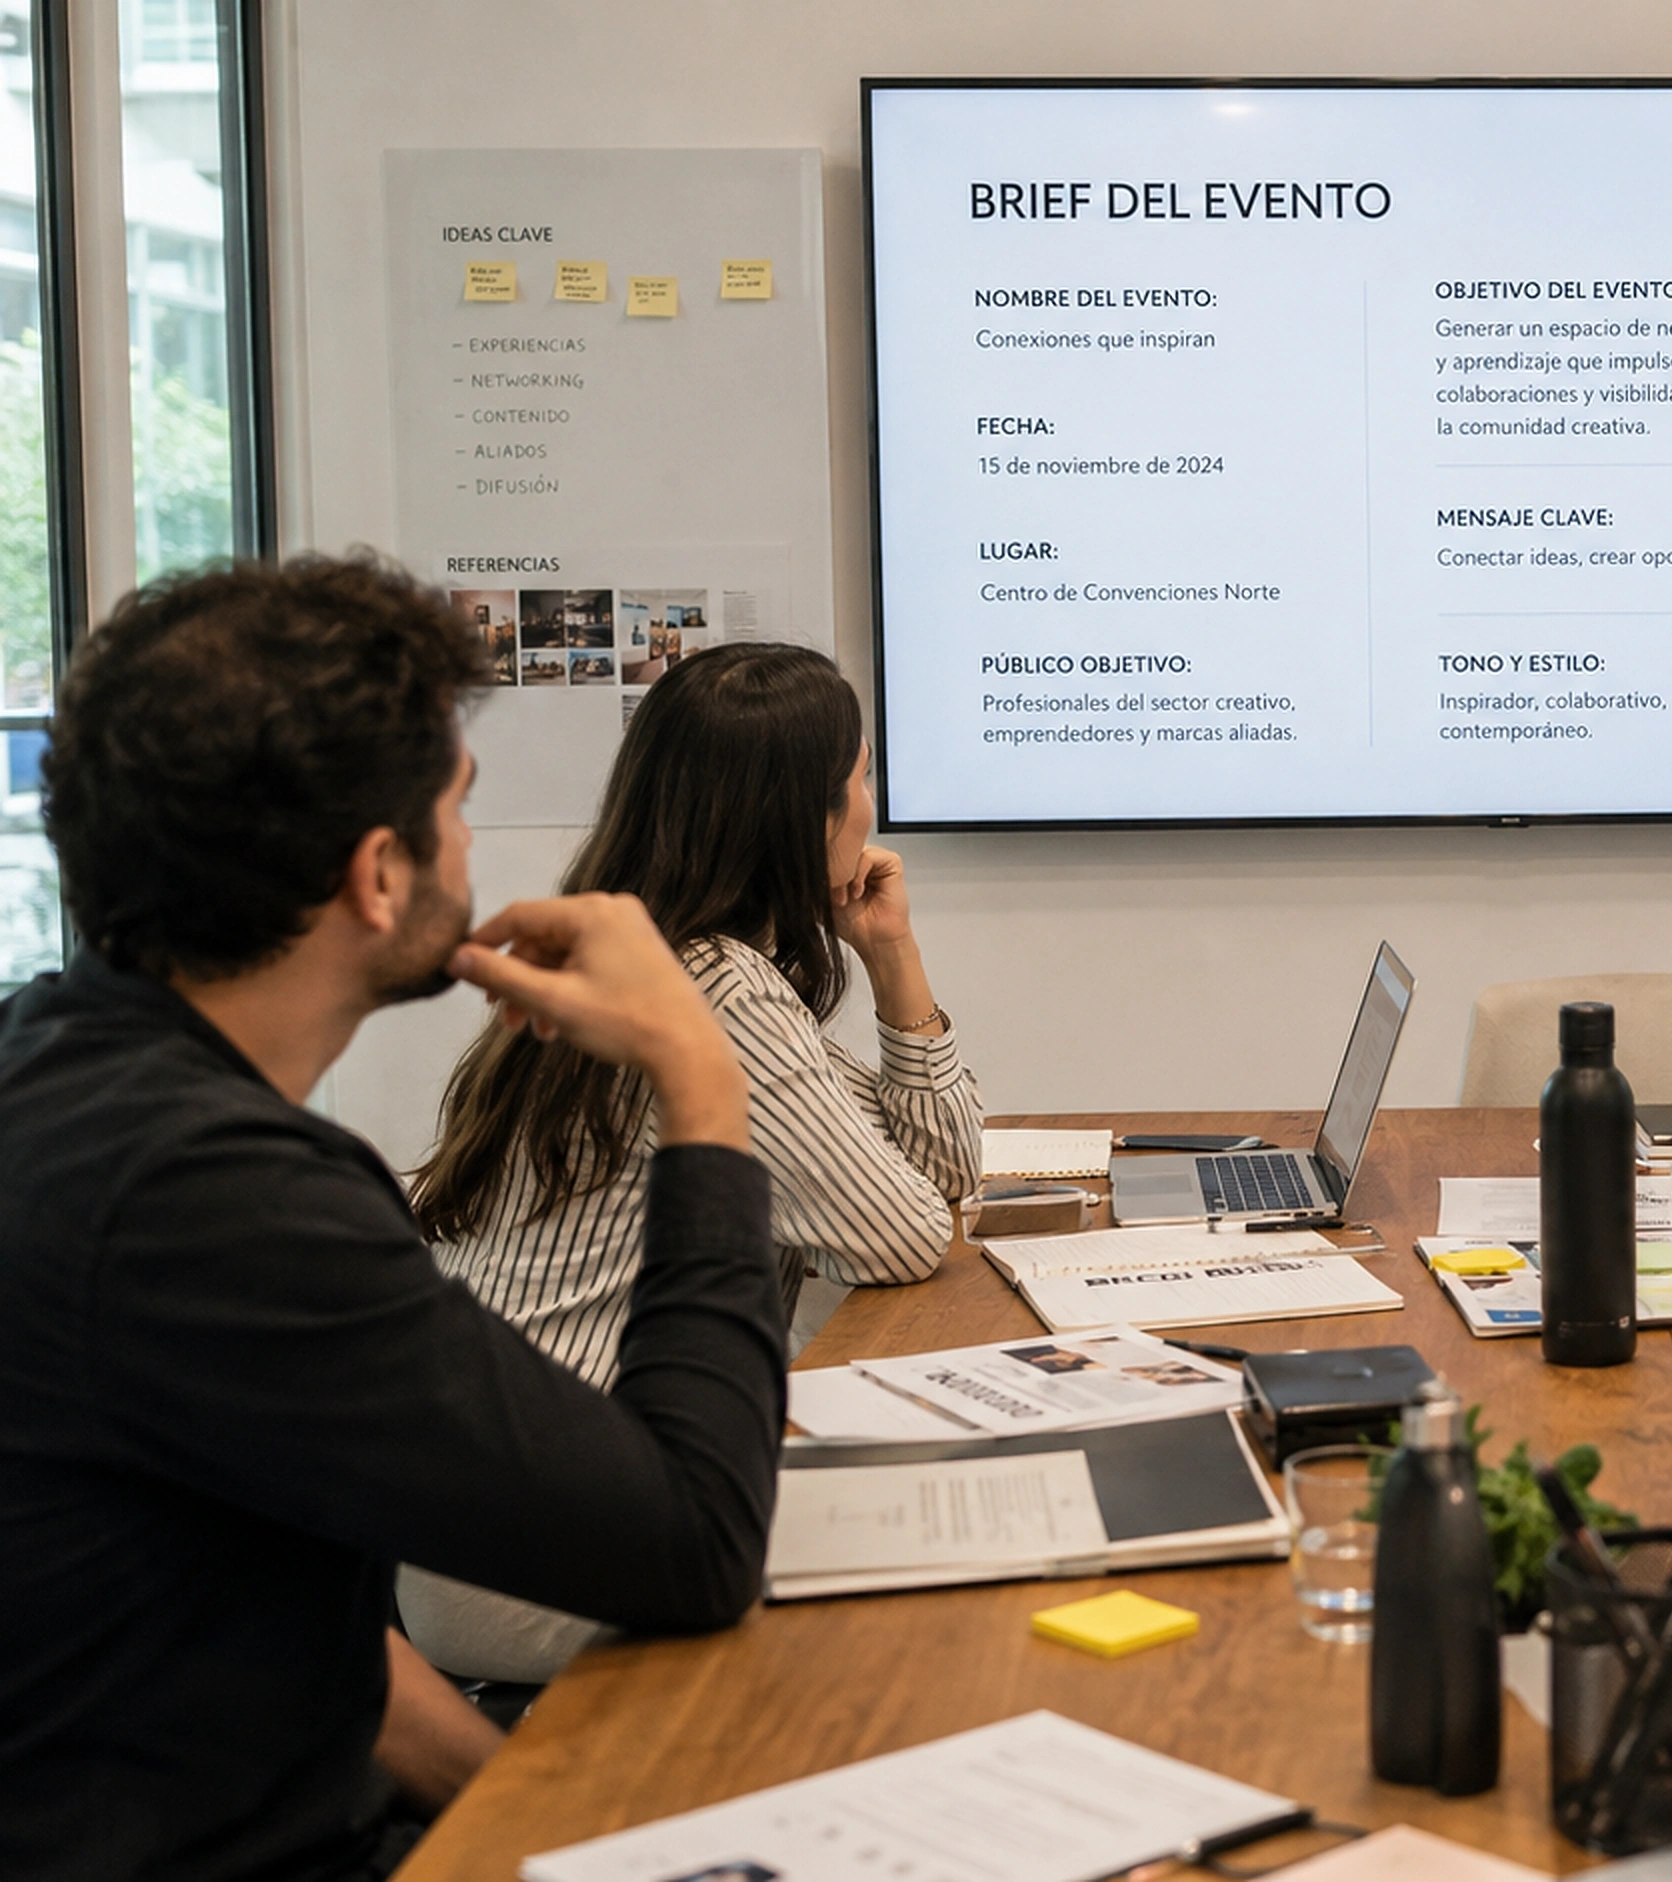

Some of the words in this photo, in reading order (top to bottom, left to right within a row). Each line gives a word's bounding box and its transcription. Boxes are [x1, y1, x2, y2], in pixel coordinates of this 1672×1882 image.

[970, 182, 1092, 219] BRIEF
[1107, 182, 1191, 219] DEL
[1204, 182, 1391, 219] EVENTO
[442, 226, 493, 243] IDEAS
[497, 226, 553, 243] CLAVE
[975, 289, 1070, 308] NOMBRE
[1077, 289, 1117, 308] DEL
[1123, 289, 1217, 308] EVENTO:
[1435, 281, 1542, 300] OBJETIVO
[1547, 281, 1587, 299] DEL
[1435, 318, 1514, 338] Generar
[1519, 323, 1544, 338] un
[1548, 318, 1622, 342] espacio
[1626, 317, 1651, 337] de
[469, 337, 586, 354] EXPERIENCIAS
[975, 329, 1092, 349] Conexiones
[1097, 333, 1135, 353] que
[1139, 329, 1216, 353] inspiran
[1435, 357, 1447, 375] y
[1452, 351, 1562, 375] aprendizaje
[1566, 355, 1603, 375] que
[471, 372, 585, 390] NETWORKING
[1435, 384, 1579, 403] colaboraciones
[1583, 389, 1595, 407] y
[471, 408, 571, 425] CONTENIDO
[977, 416, 1055, 436] FECHA:
[1437, 417, 1453, 436] la
[1458, 416, 1566, 436] comunidad
[1570, 416, 1651, 436] creativa.
[473, 443, 548, 460] ALIADOS
[979, 456, 1001, 475] 15
[1005, 455, 1031, 475] de
[1036, 455, 1141, 475] noviembre
[1145, 455, 1171, 475] de
[1176, 455, 1224, 475] 2024
[475, 473, 559, 496] DIFUSIÓN
[1437, 508, 1534, 527] MENSAJE
[1540, 508, 1613, 527] CLAVE:
[980, 541, 1059, 561] LUGAR:
[1437, 547, 1525, 567] Conectar
[1530, 546, 1583, 568] ideas,
[1588, 551, 1637, 566] crear
[446, 556, 561, 573] REFERENCIAS
[980, 583, 1049, 602] Centro
[1053, 583, 1078, 602] de
[1083, 583, 1219, 602] Convenciones
[1224, 583, 1281, 601] Norte
[981, 652, 1075, 675] PÚBLICO
[1080, 655, 1192, 674] OBJETIVO:
[1438, 654, 1504, 673] TONO
[1509, 654, 1523, 673] Y
[1529, 653, 1605, 673] ESTILO:
[983, 692, 1111, 713] Profesionales
[1115, 692, 1145, 712] del
[1150, 695, 1210, 712] sector
[1215, 692, 1296, 712] creativo,
[1440, 691, 1540, 714] Inspirador,
[1545, 690, 1667, 711] colaborativo,
[982, 724, 1135, 747] emprendedores
[1139, 728, 1151, 747] y
[1156, 727, 1224, 742] marcas
[1228, 722, 1297, 741] aliadas.
[1439, 721, 1593, 744] contemporáneo.
